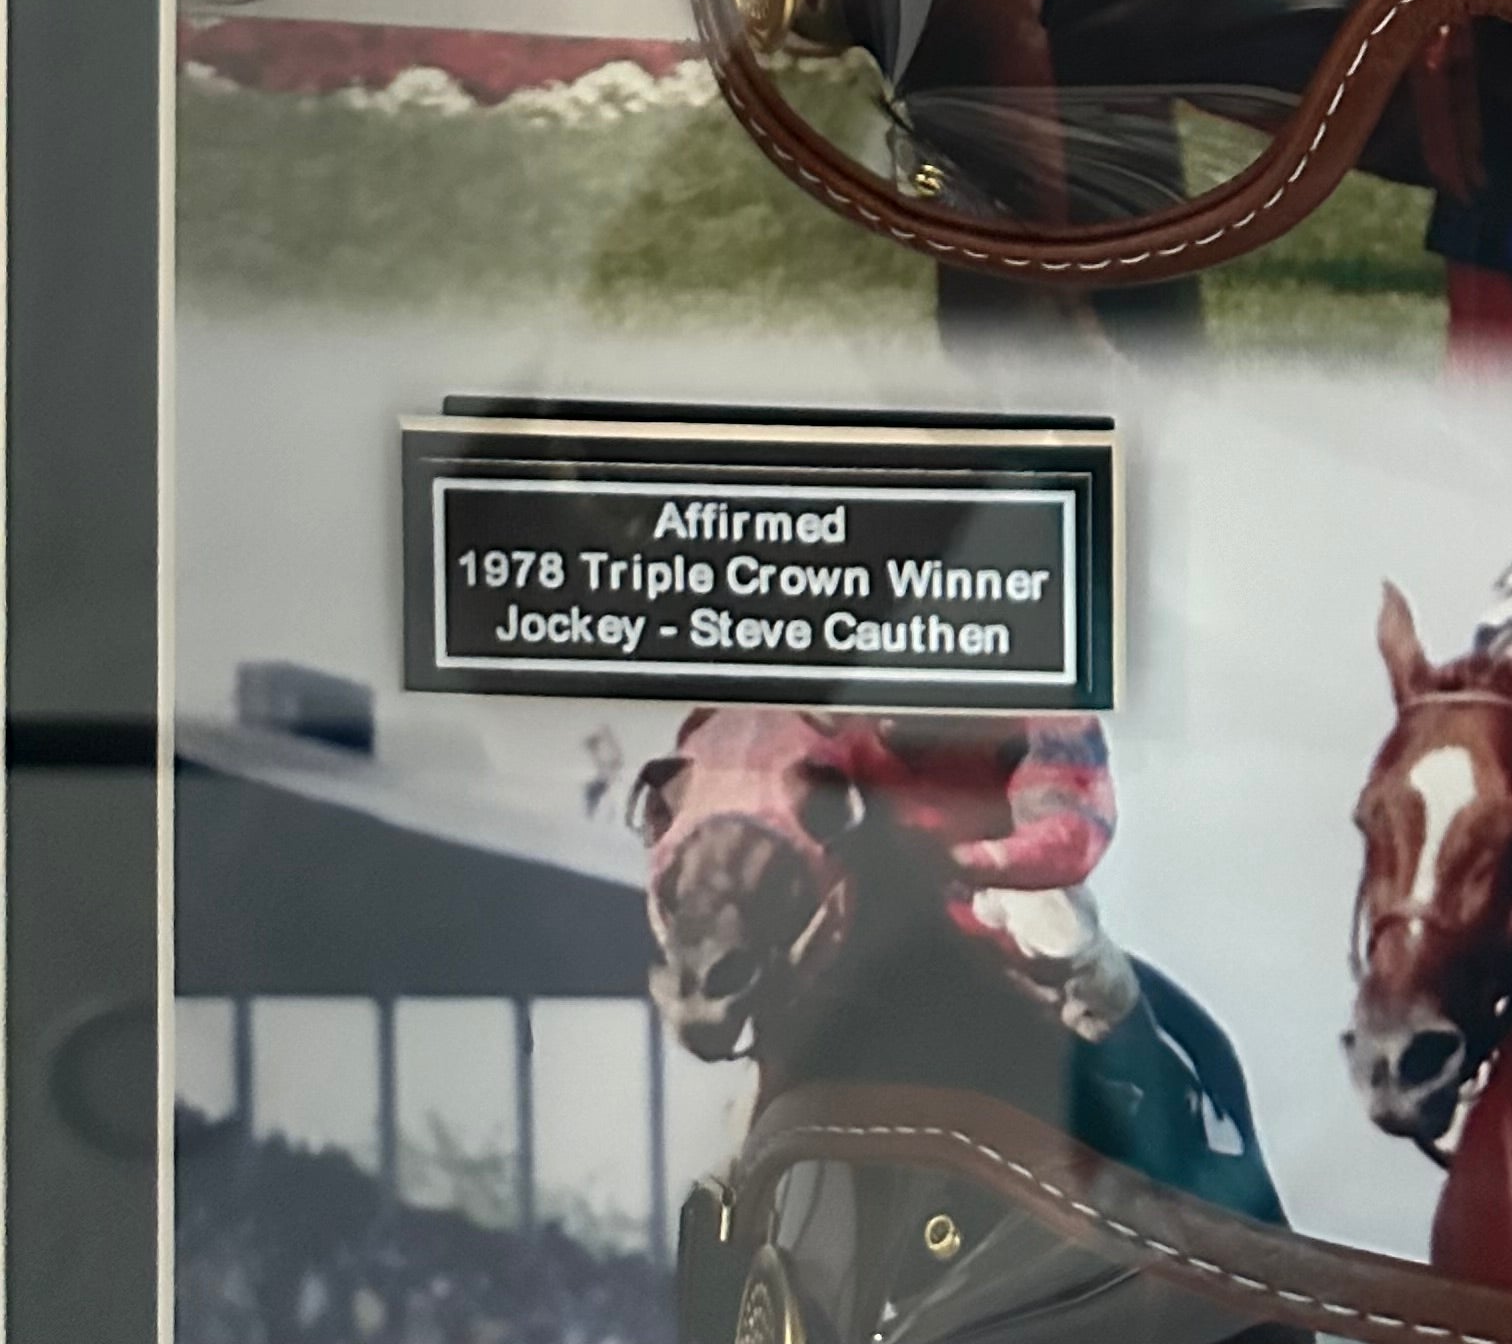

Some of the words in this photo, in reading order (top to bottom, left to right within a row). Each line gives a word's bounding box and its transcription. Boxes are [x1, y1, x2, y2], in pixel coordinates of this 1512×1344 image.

[653, 502, 845, 543] Affirmed
[460, 551, 564, 588] 1978
[580, 553, 713, 600] Triple
[727, 556, 869, 597] Crown
[887, 560, 1049, 602] Winner
[496, 605, 645, 653] Jockey
[660, 627, 677, 636] -
[690, 608, 811, 650] Steve
[824, 612, 1009, 656] Cauthen
